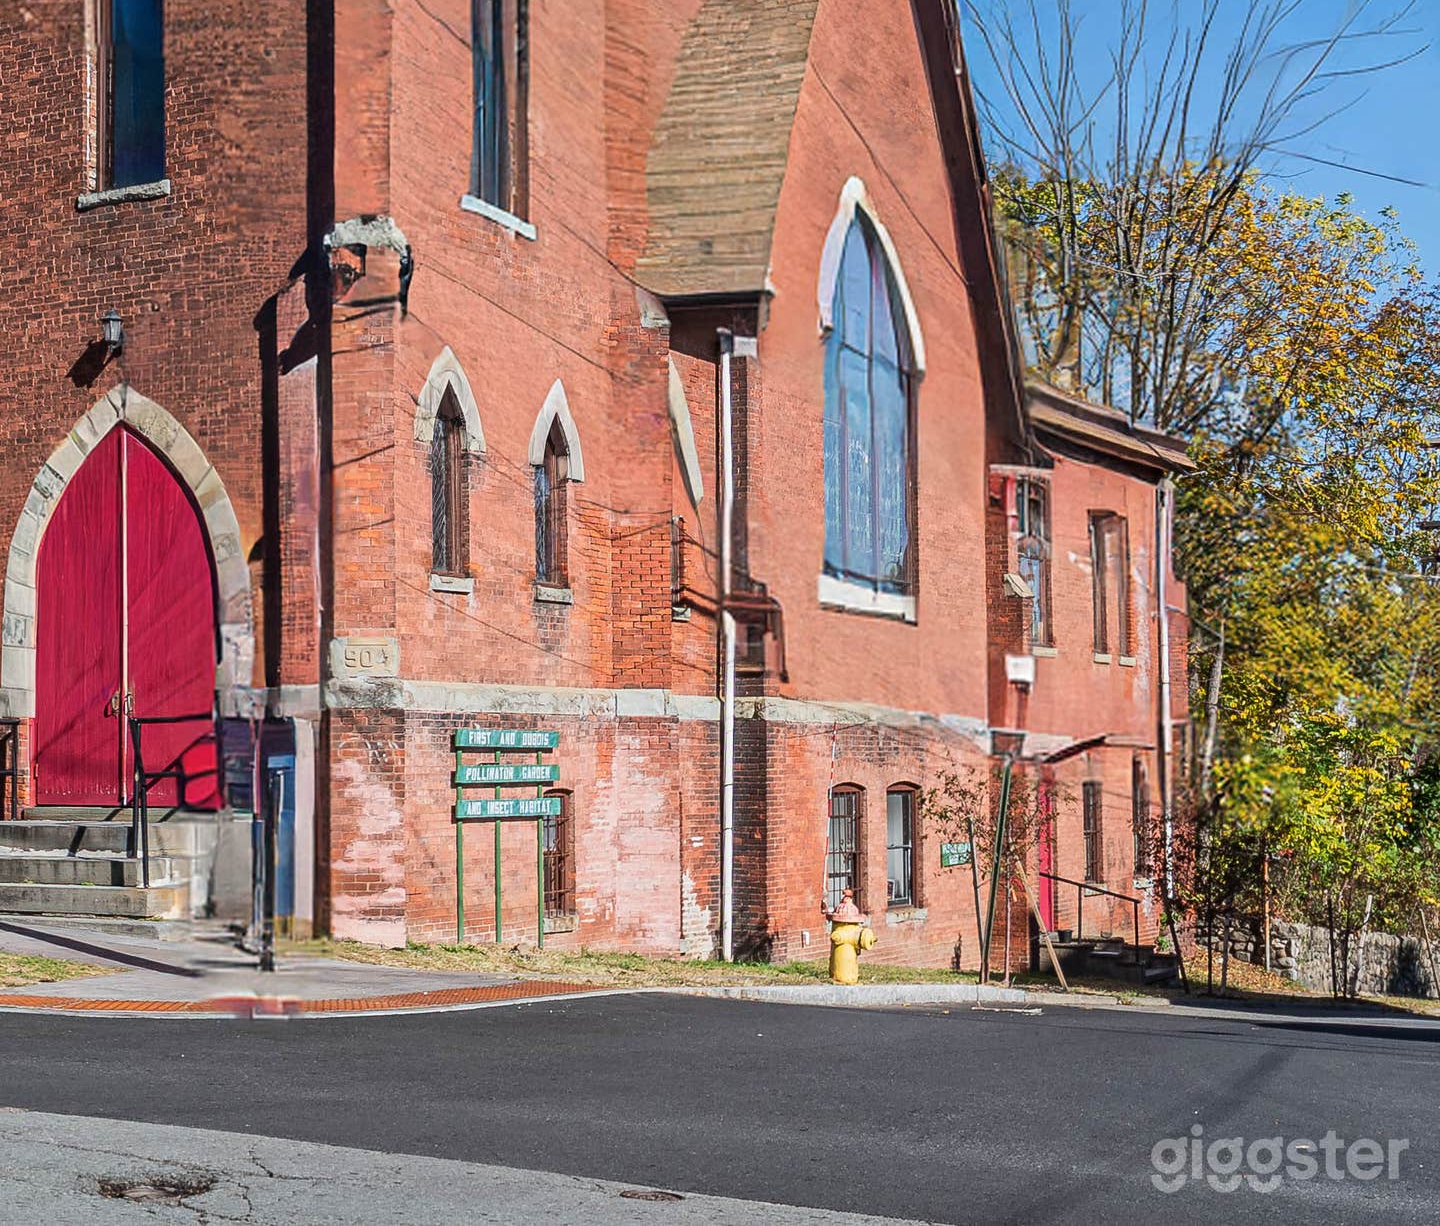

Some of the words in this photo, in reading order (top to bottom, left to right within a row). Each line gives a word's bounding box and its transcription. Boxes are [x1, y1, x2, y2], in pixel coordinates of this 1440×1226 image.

[468, 731, 492, 745] FIRST
[500, 732, 515, 745] AND
[522, 733, 549, 746] DUBOIS
[465, 767, 513, 781] POLLINATOR
[521, 766, 550, 779] GARDEN
[466, 801, 482, 815] AND
[487, 801, 514, 814] INSECT
[519, 800, 551, 814] HABITAT
